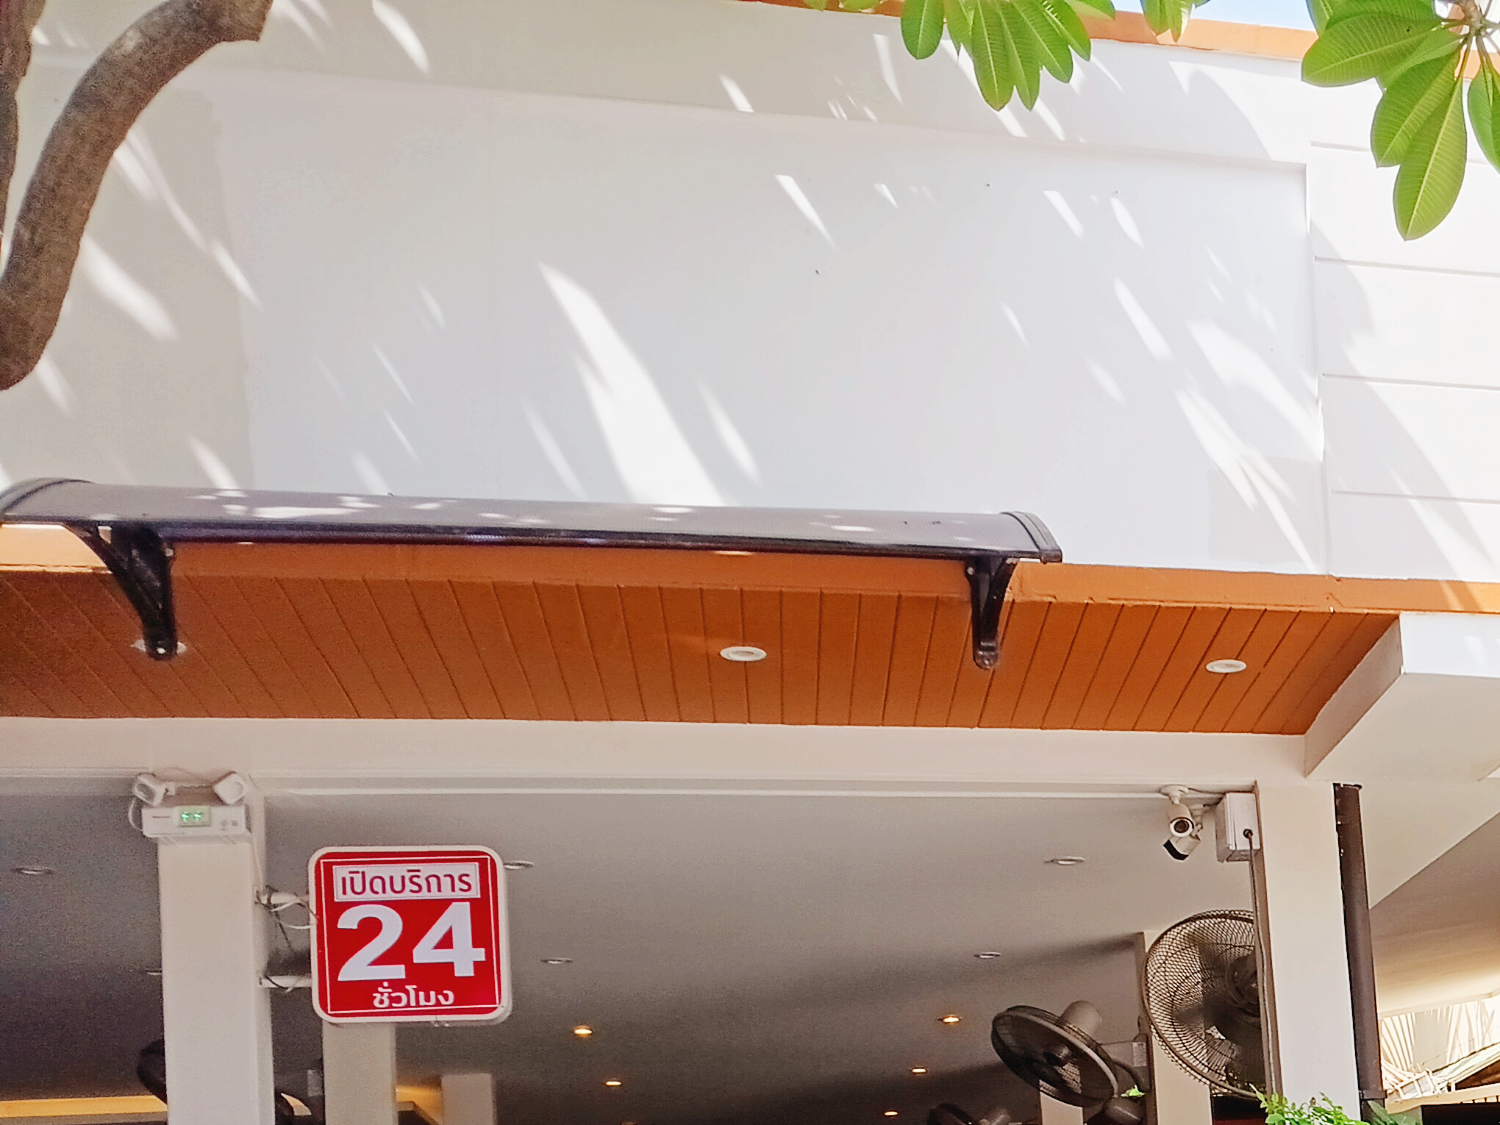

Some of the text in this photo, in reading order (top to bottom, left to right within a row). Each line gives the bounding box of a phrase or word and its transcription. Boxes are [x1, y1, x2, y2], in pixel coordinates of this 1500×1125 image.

[341, 868, 473, 896] เปิดบริการ
[337, 901, 486, 982] 24
[372, 982, 455, 1009] ชั่วโมง
